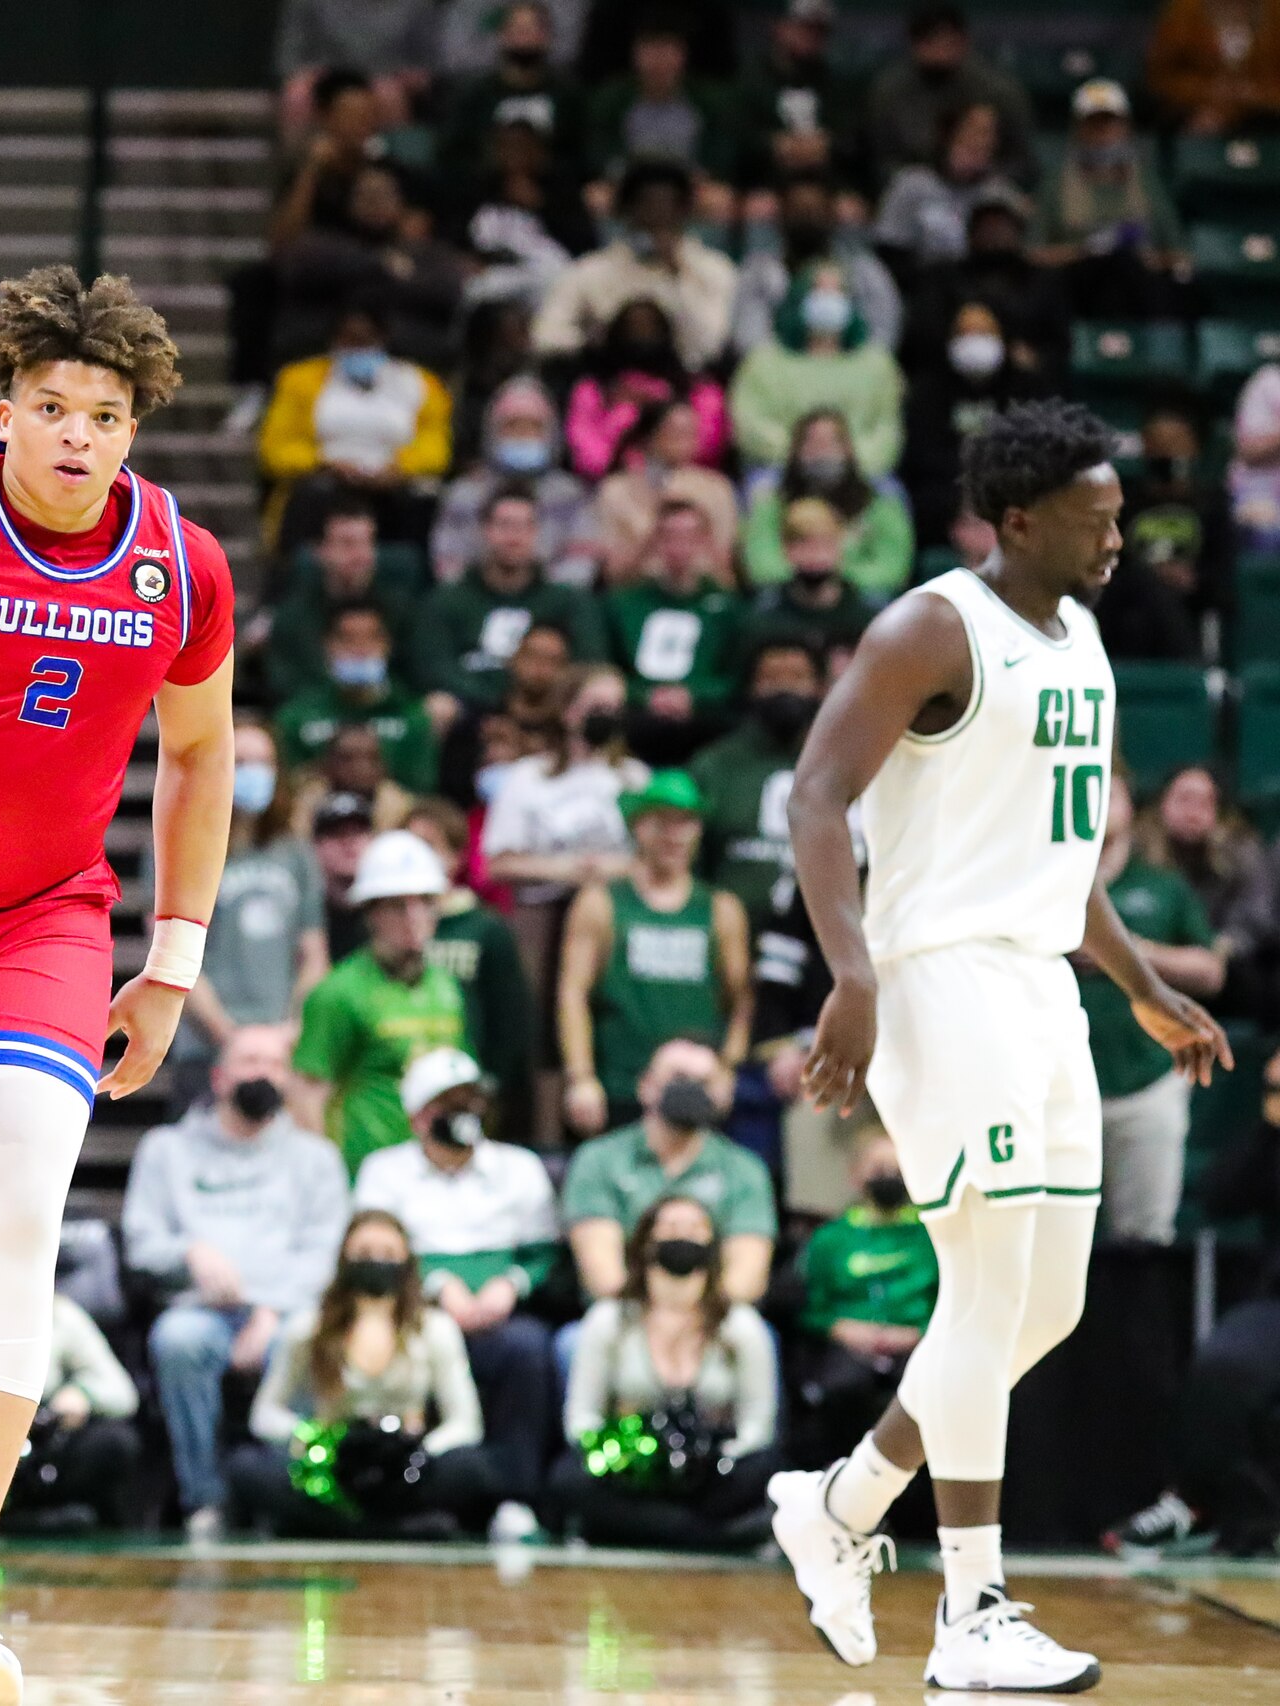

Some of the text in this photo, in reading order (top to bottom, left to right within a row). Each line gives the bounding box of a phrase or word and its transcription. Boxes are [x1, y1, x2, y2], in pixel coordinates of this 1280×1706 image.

[18, 655, 84, 730] 2
[1033, 688, 1105, 747] CLT
[1051, 765, 1103, 843] 10
